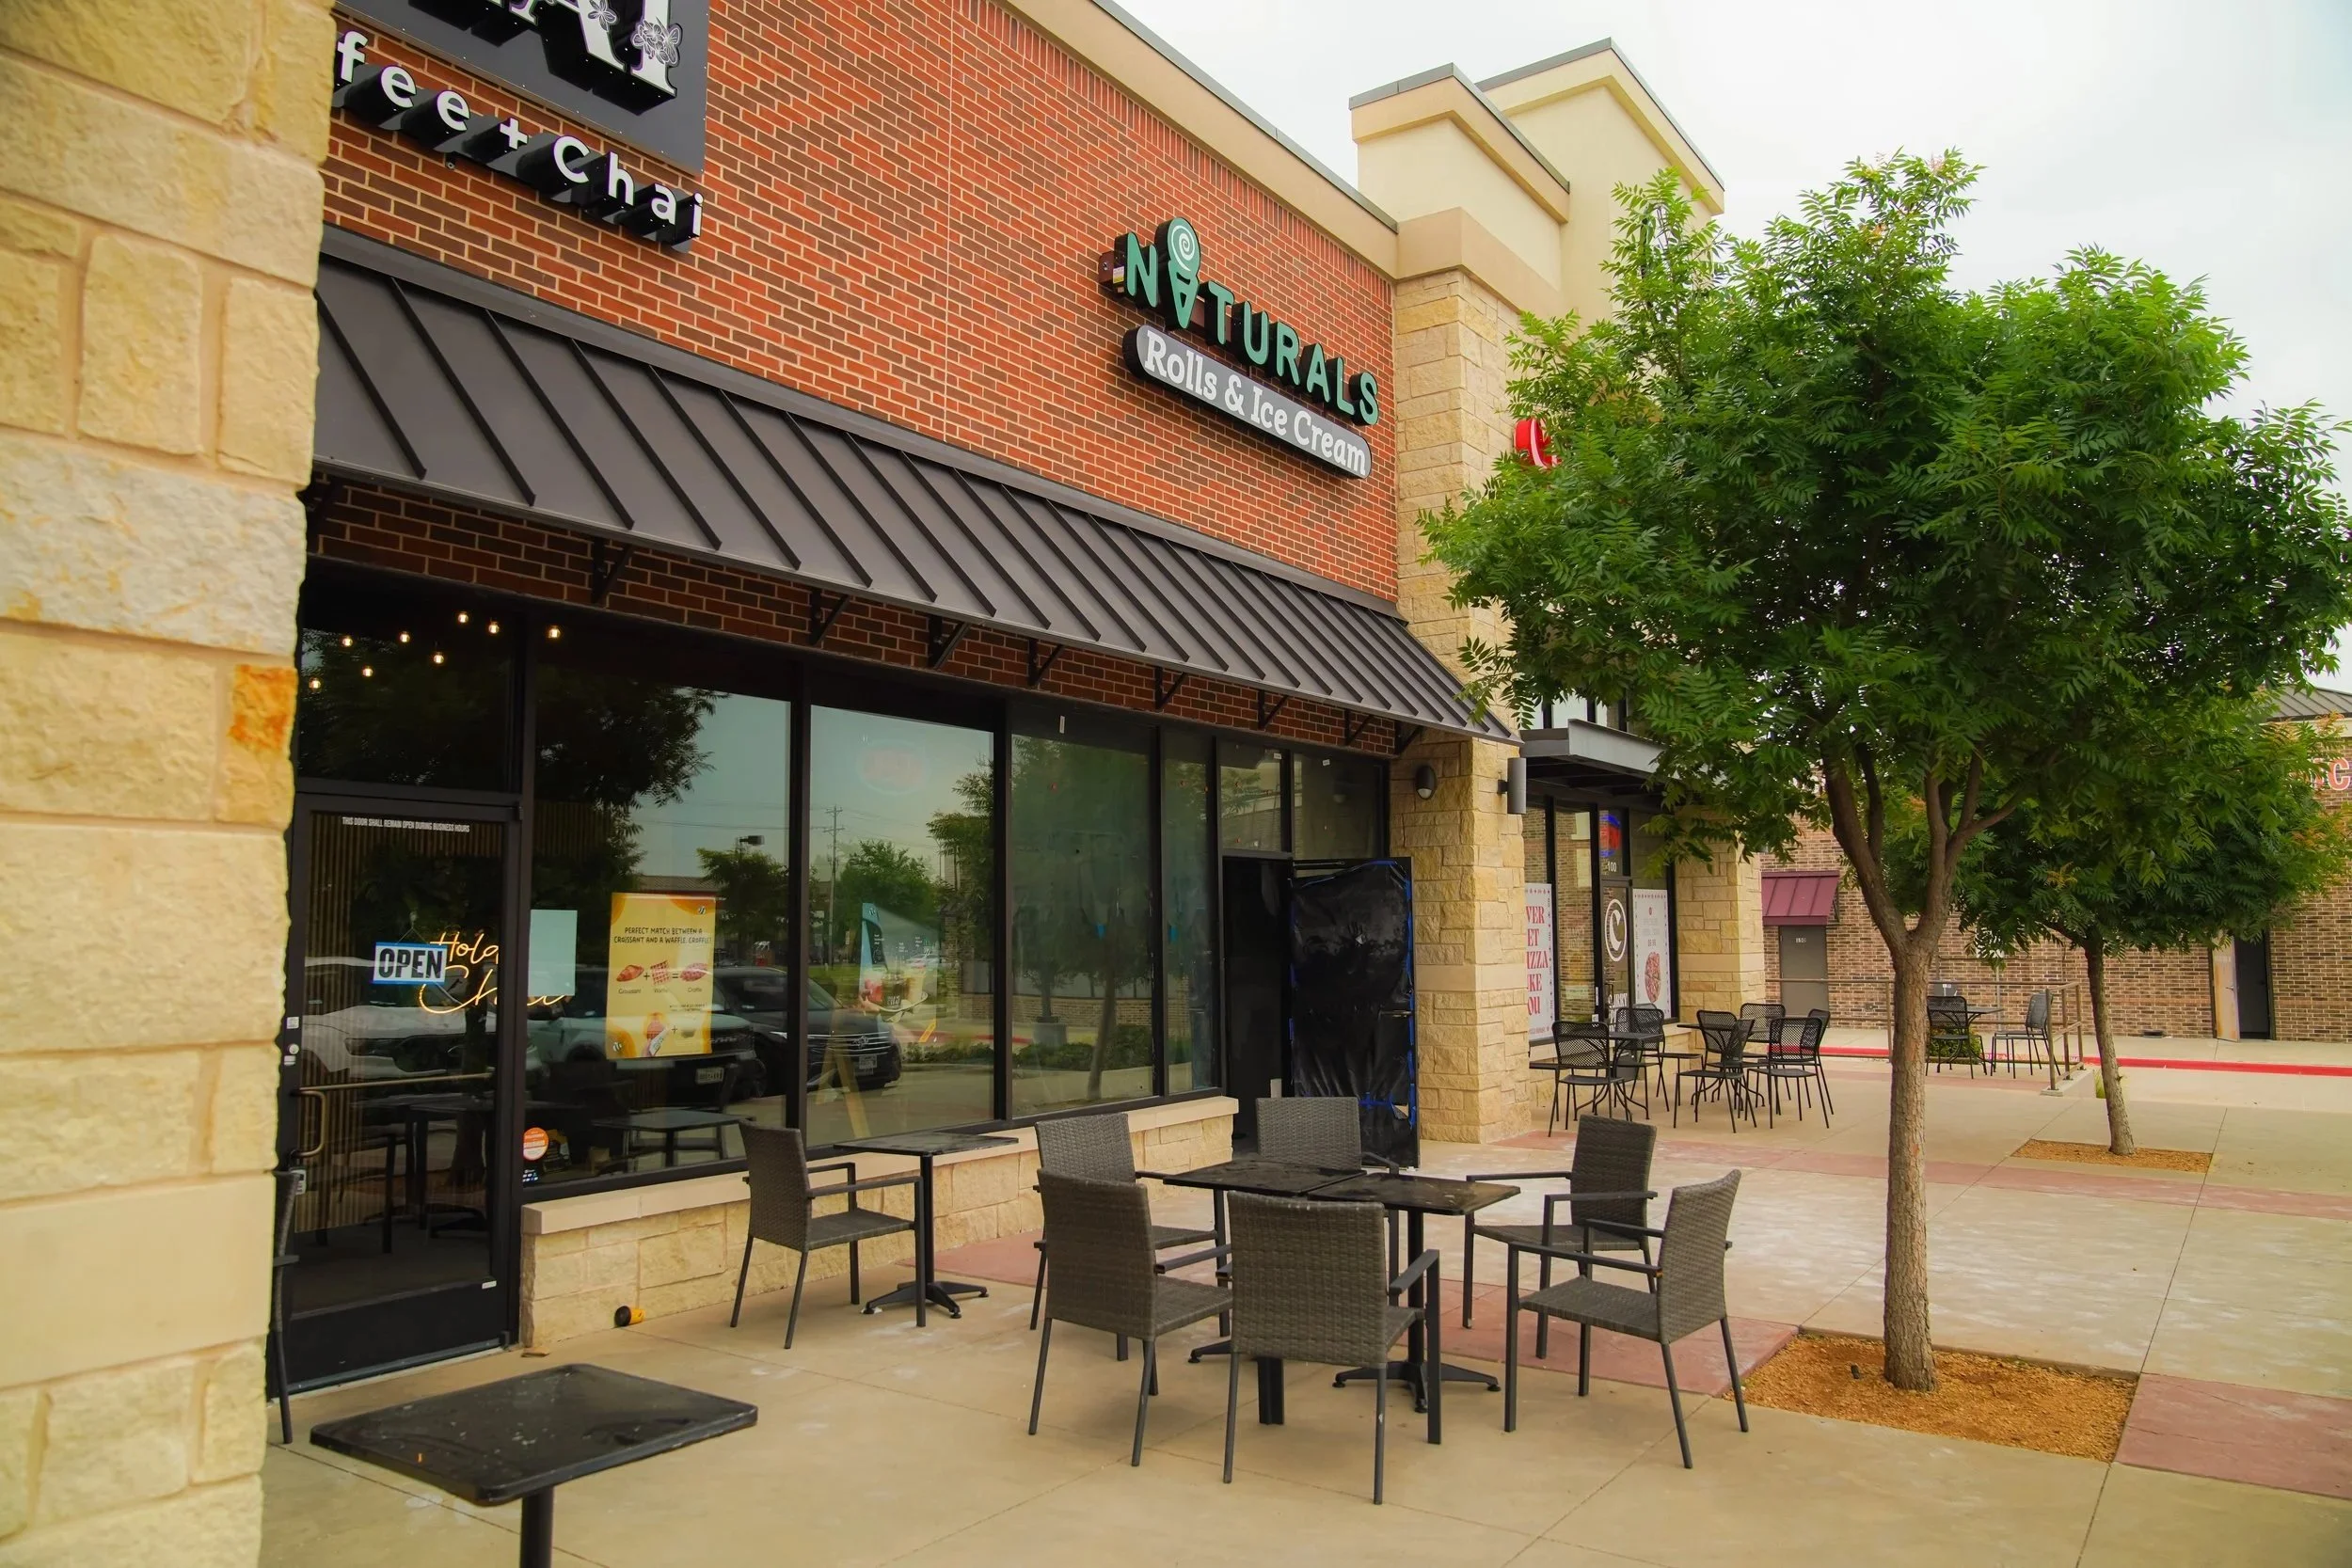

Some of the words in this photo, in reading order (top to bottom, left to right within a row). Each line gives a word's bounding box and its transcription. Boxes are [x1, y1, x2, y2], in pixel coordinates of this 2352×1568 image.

[553, 135, 704, 238] Chai
[1126, 217, 1379, 425] NATURALS
[1144, 330, 1217, 401] Rolls
[1224, 373, 1246, 417] &
[1251, 384, 1288, 436] Ice
[1294, 410, 1367, 476] Cream
[342, 816, 354, 825] THIS
[354, 817, 368, 827] DOOR
[368, 818, 384, 828] SHALL
[384, 819, 403, 829] REMAIN
[403, 820, 415, 830] OPEN
[415, 821, 433, 831] DURING
[433, 823, 454, 832] BUSINESS
[454, 824, 470, 832] HOURS
[1607, 862, 1617, 873] 100
[624, 927, 649, 935] PERFECT
[650, 927, 671, 935] MATCH
[378, 947, 443, 979] OPEN
